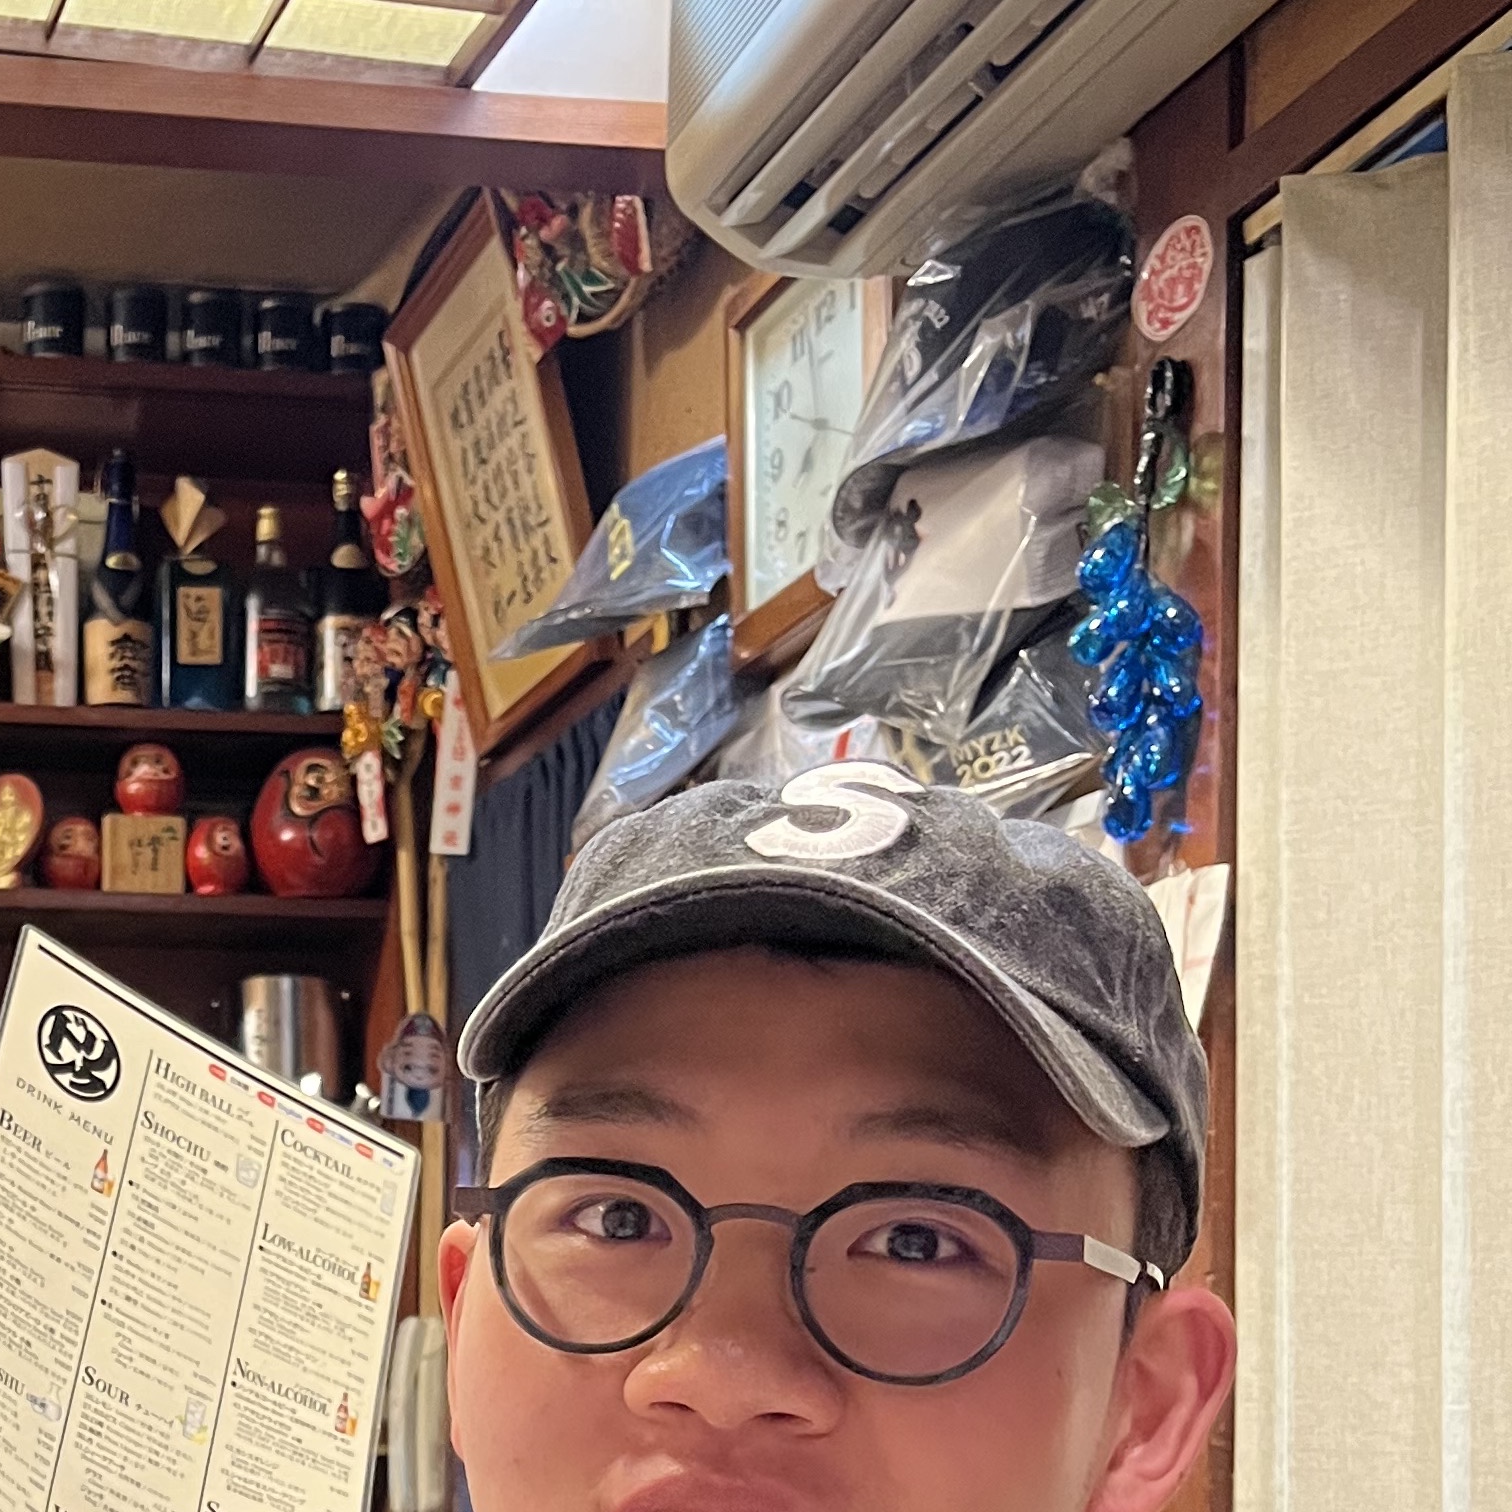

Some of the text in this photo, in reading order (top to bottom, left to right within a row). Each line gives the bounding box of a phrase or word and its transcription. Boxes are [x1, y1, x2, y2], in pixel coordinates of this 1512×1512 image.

[951, 723, 1027, 767] MYZK
[956, 745, 1036, 789] 2022
[15, 1076, 115, 1146] DRINK MENU
[154, 1057, 240, 1120] HIGH BALL
[140, 1110, 212, 1163] SHOCHU
[280, 1128, 356, 1181] COCKTAIL
[261, 1222, 360, 1287] LOW-ALCOHOL
[81, 1365, 131, 1407] SOUR
[232, 1357, 331, 1417] NON-ALCOHOL
